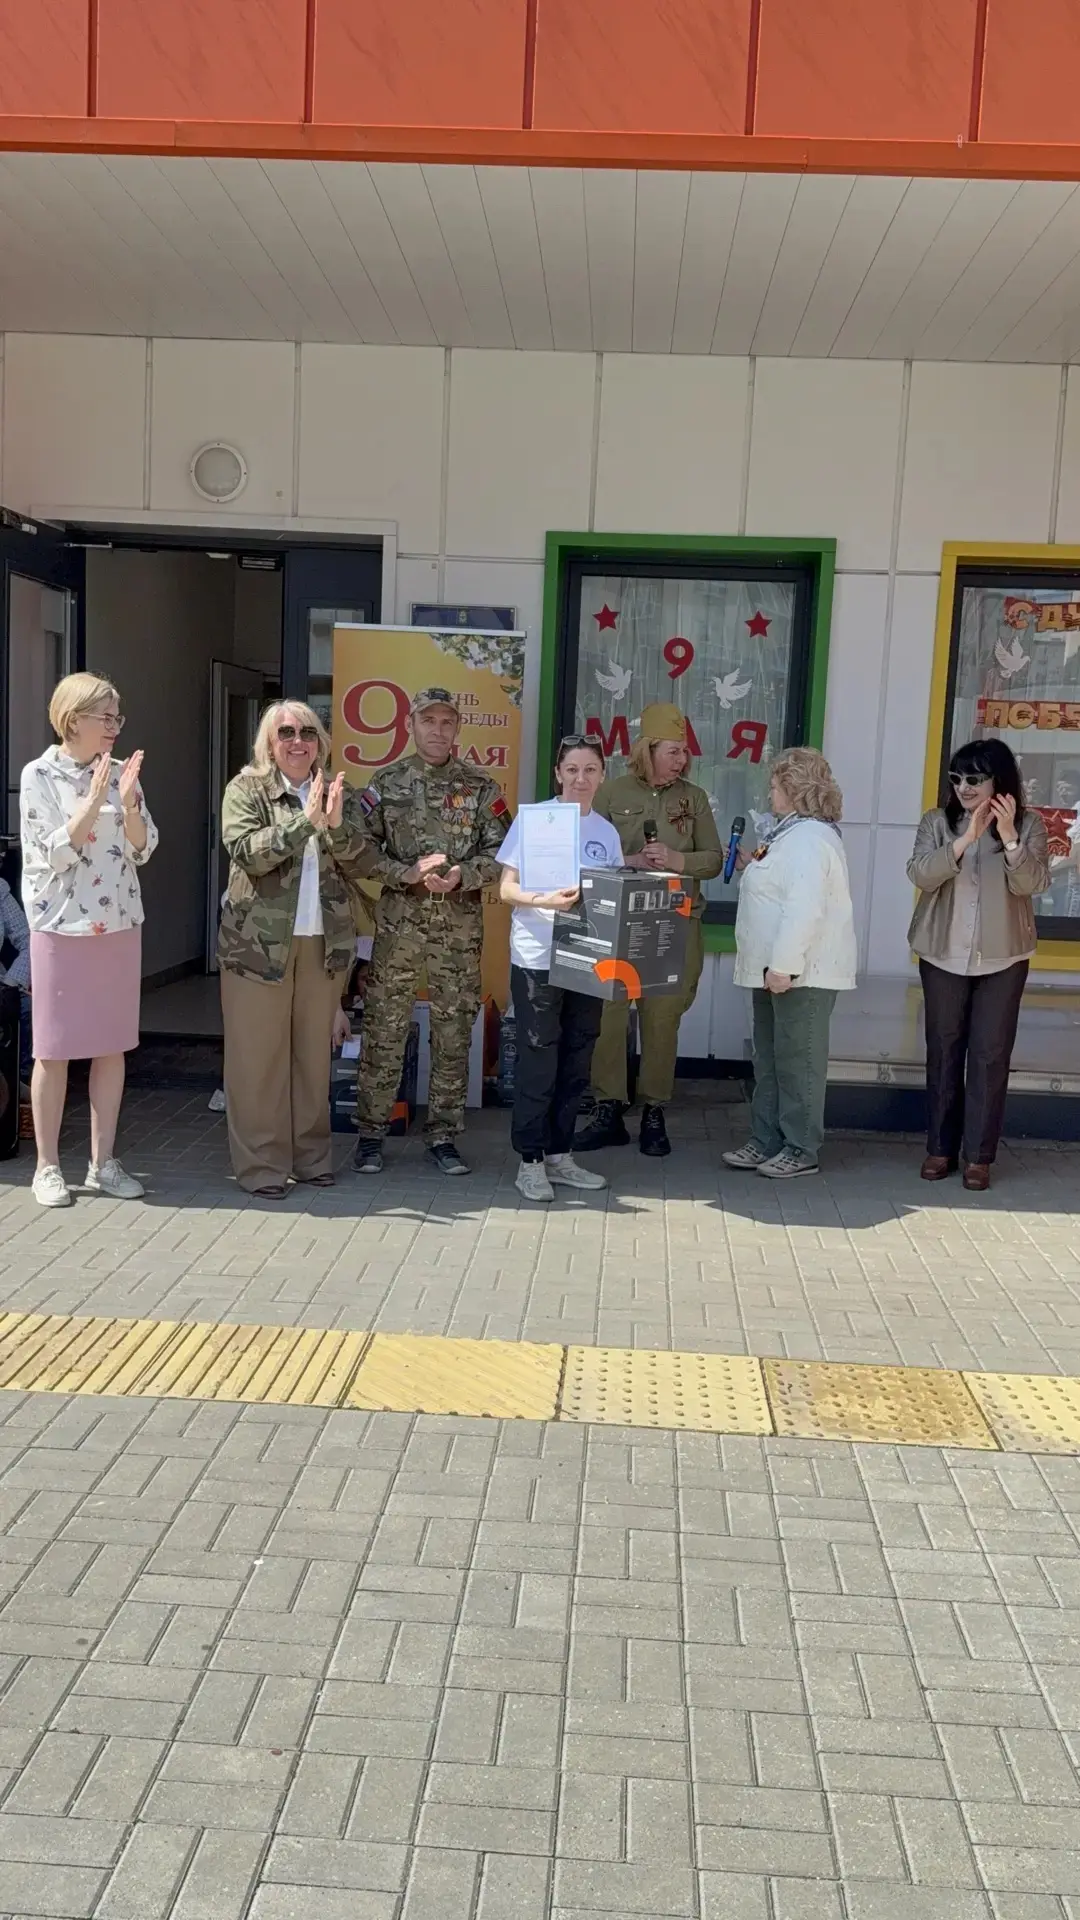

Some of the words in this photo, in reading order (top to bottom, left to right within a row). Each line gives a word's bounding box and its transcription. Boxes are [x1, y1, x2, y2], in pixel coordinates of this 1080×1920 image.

[663, 637, 695, 680] 9
[343, 681, 411, 767] 9
[460, 713, 509, 728] БЕДЫ
